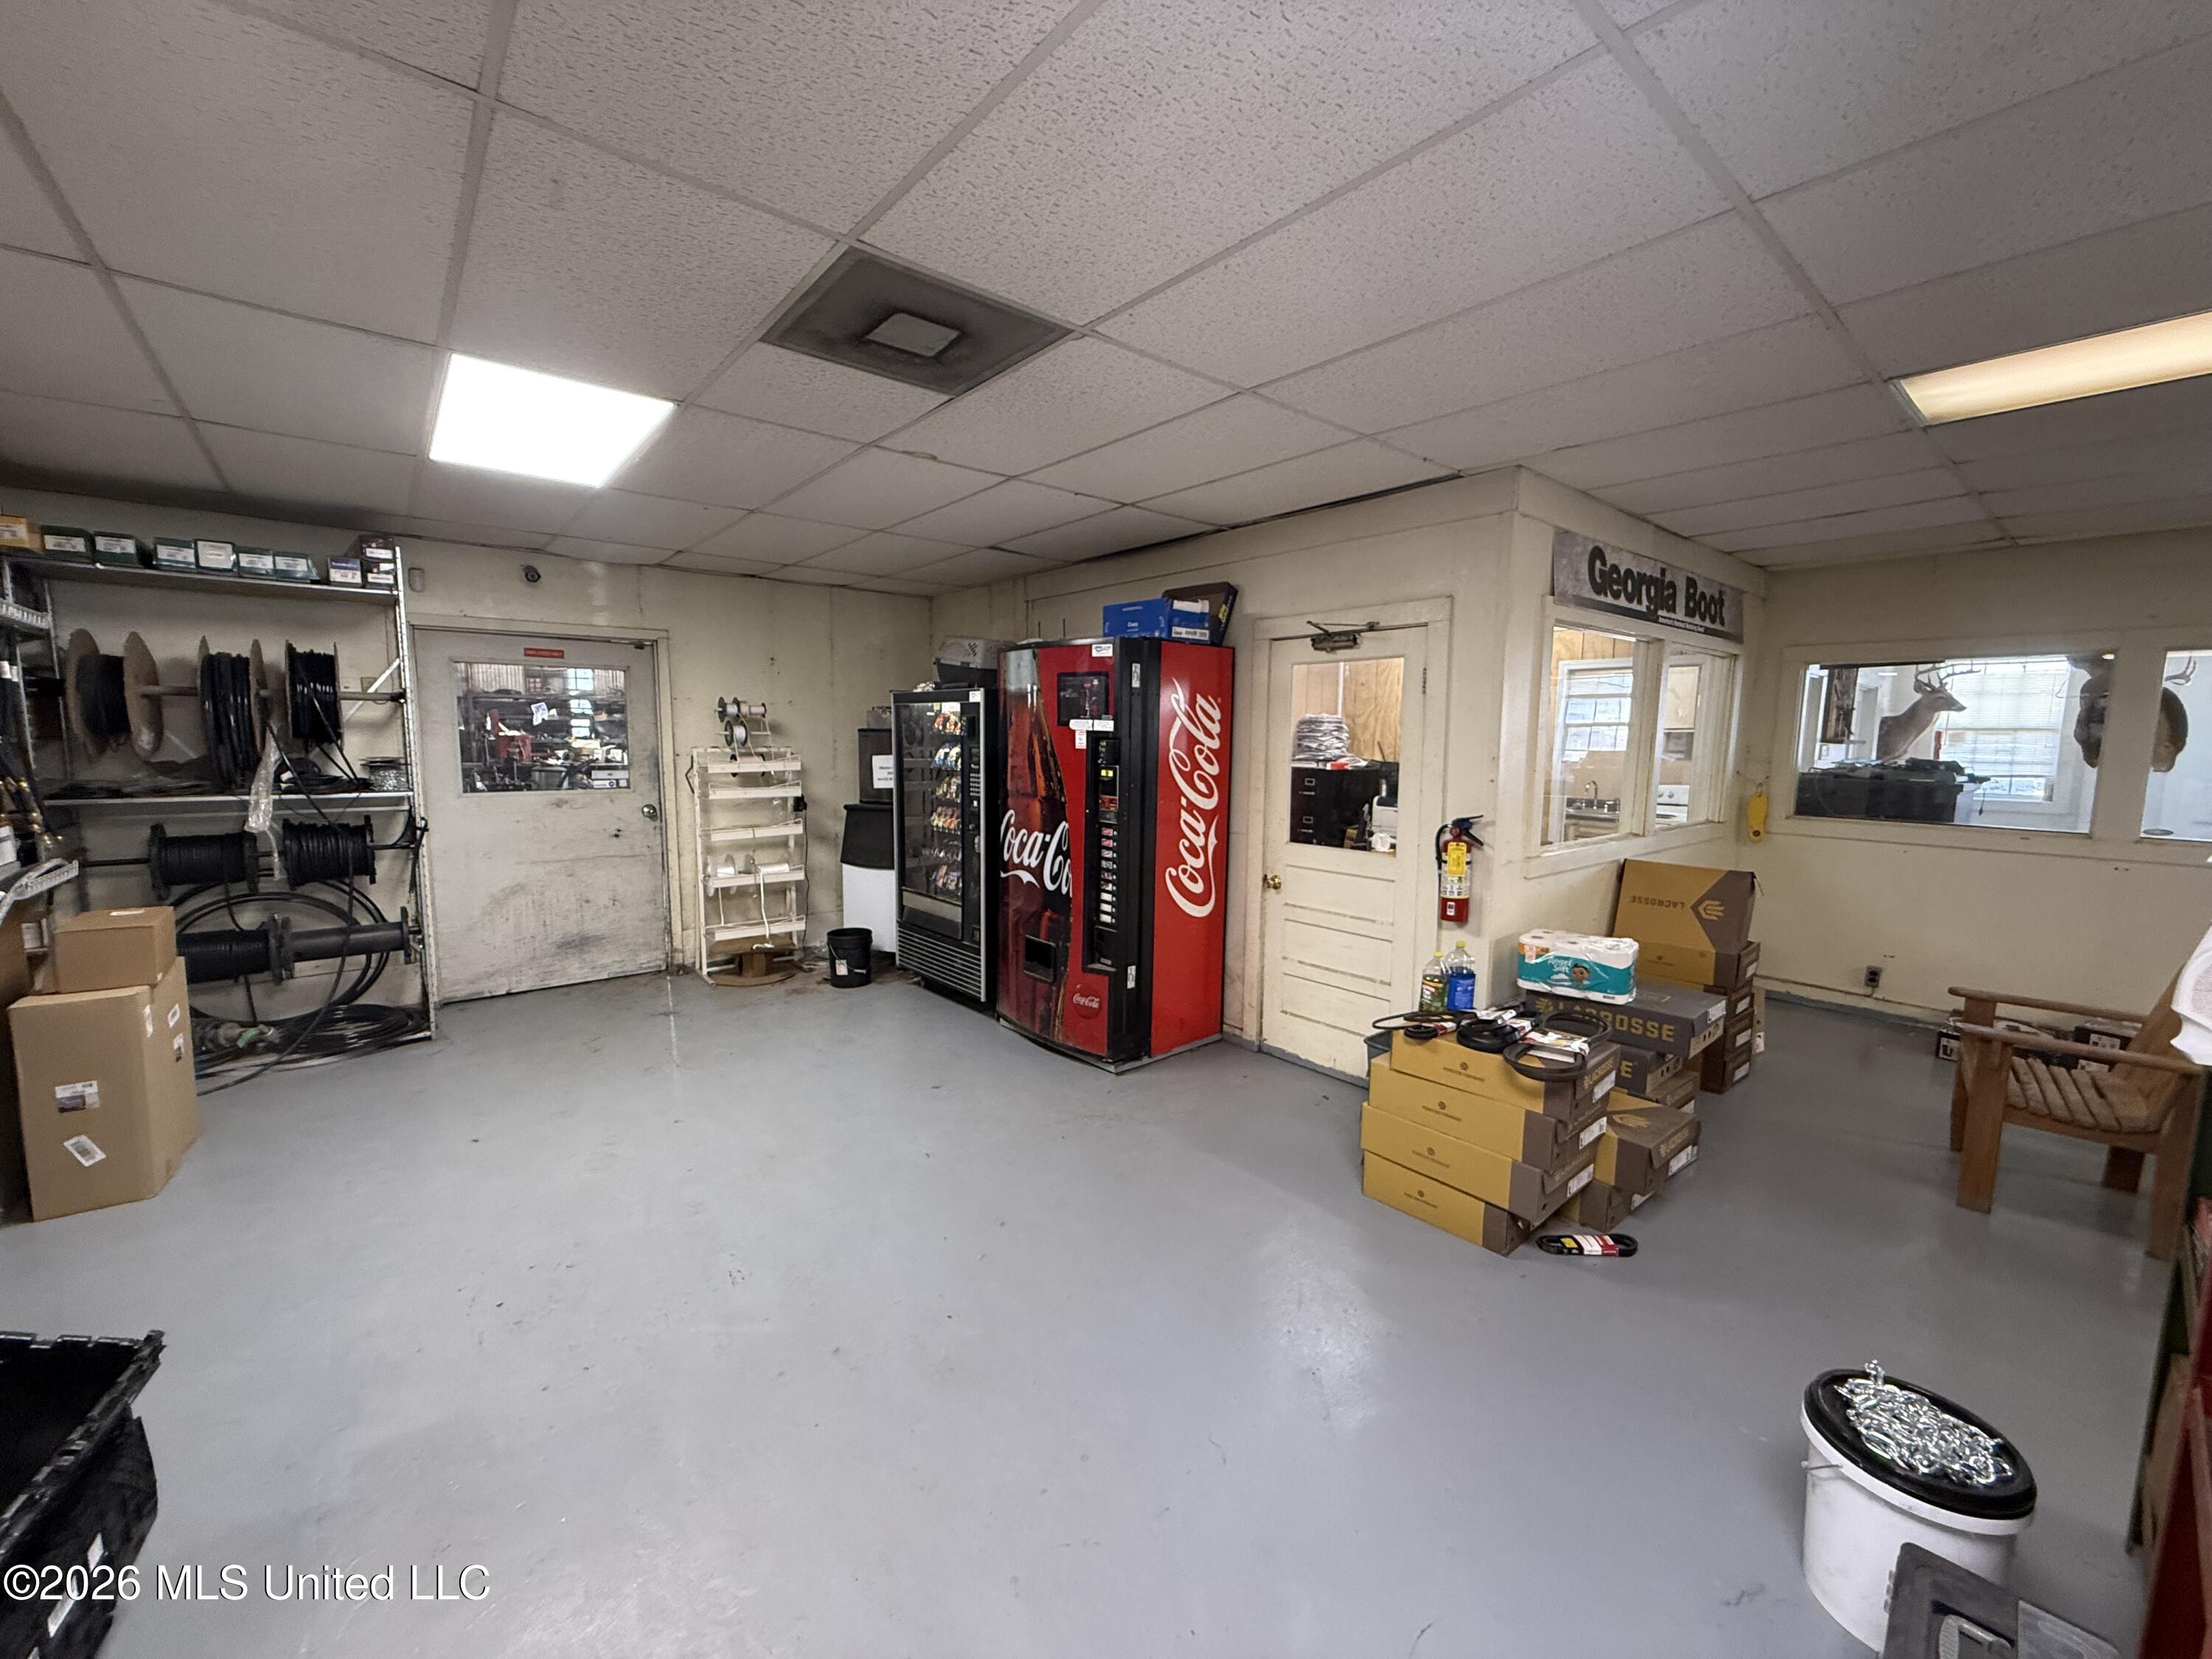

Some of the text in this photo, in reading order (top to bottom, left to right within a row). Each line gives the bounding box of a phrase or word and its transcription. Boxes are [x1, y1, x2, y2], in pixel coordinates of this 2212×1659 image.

[1588, 546, 1725, 626] Georgia Boot
[1165, 677, 1221, 917] Coca-Cola
[1000, 810, 1072, 898] Coca-Co
[1630, 895, 1685, 910] LACROSSE
[1558, 1001, 1675, 1042] ROSSE
